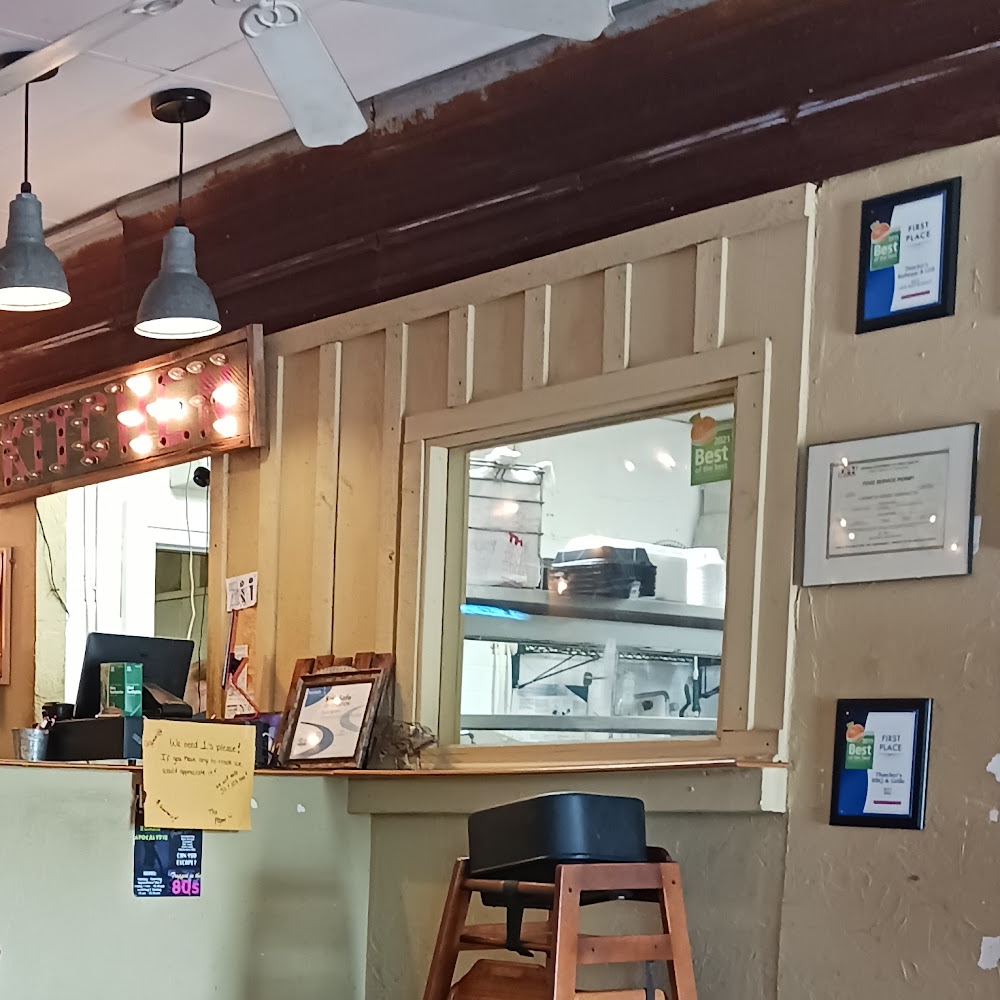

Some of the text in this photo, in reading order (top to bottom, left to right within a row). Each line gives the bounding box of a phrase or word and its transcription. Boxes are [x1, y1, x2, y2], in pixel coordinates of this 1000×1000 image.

[908, 221, 929, 232] FIRST
[906, 231, 931, 242] PLACE
[873, 242, 899, 256] Best
[0, 362, 238, 487] KITCHEN
[694, 445, 728, 466] Best
[169, 738, 181, 748] We
[881, 734, 901, 742] FIRST
[848, 743, 872, 755] Best
